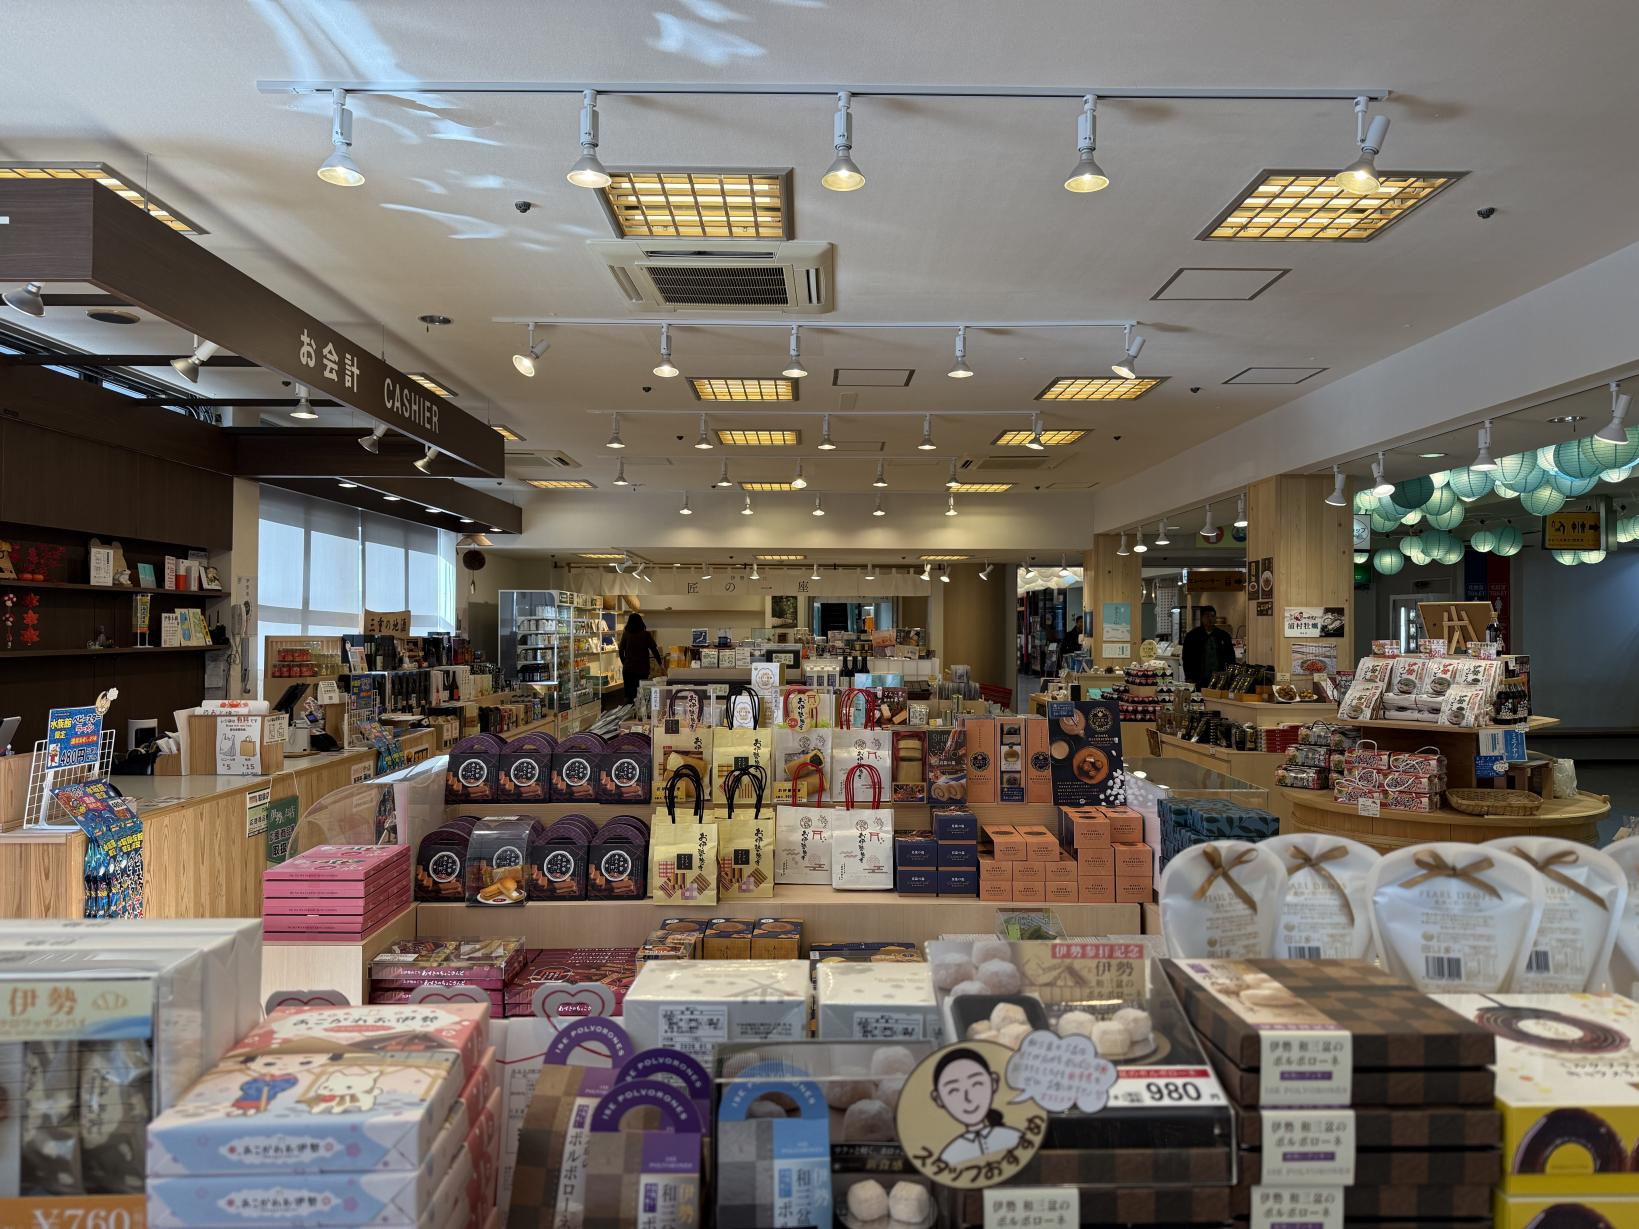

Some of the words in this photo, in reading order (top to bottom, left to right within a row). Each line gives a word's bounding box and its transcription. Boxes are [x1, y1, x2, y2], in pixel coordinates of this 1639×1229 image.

[300, 328, 360, 393] お会計
[384, 378, 439, 433] CASHIER
[1096, 961, 1134, 977] 伊勢
[9, 986, 77, 1017] 伊勢
[571, 1025, 625, 1057] POLVORONES
[1270, 1041, 1292, 1053] 伊勢
[638, 1057, 702, 1088] POLVORONES
[618, 1088, 688, 1120] POLVORONES
[1146, 1081, 1201, 1102] 980
[1272, 1121, 1294, 1133] 伊勢
[913, 1115, 1045, 1182] スタッフおすすめ
[993, 1201, 1016, 1213] 伊勢
[1260, 1192, 1283, 1205] 伊勢
[33, 1208, 131, 1229] ¥760
